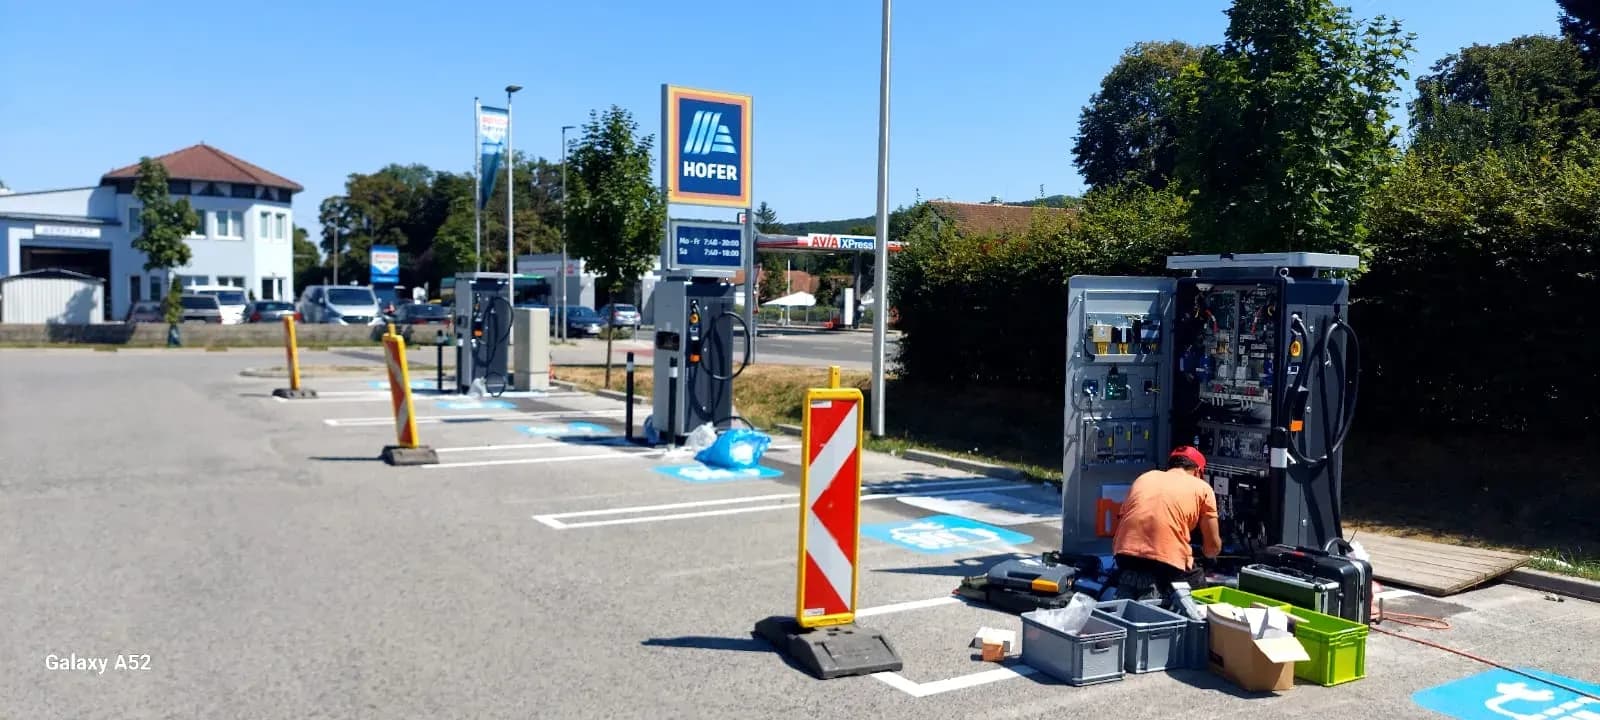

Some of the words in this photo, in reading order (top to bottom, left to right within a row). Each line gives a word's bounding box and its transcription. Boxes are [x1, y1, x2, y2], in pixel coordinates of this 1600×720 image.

[683, 160, 738, 181] HOFER
[679, 237, 690, 245] Mo
[811, 234, 838, 249] AVIA
[841, 238, 874, 250] XPress
[679, 247, 688, 255] Sa
